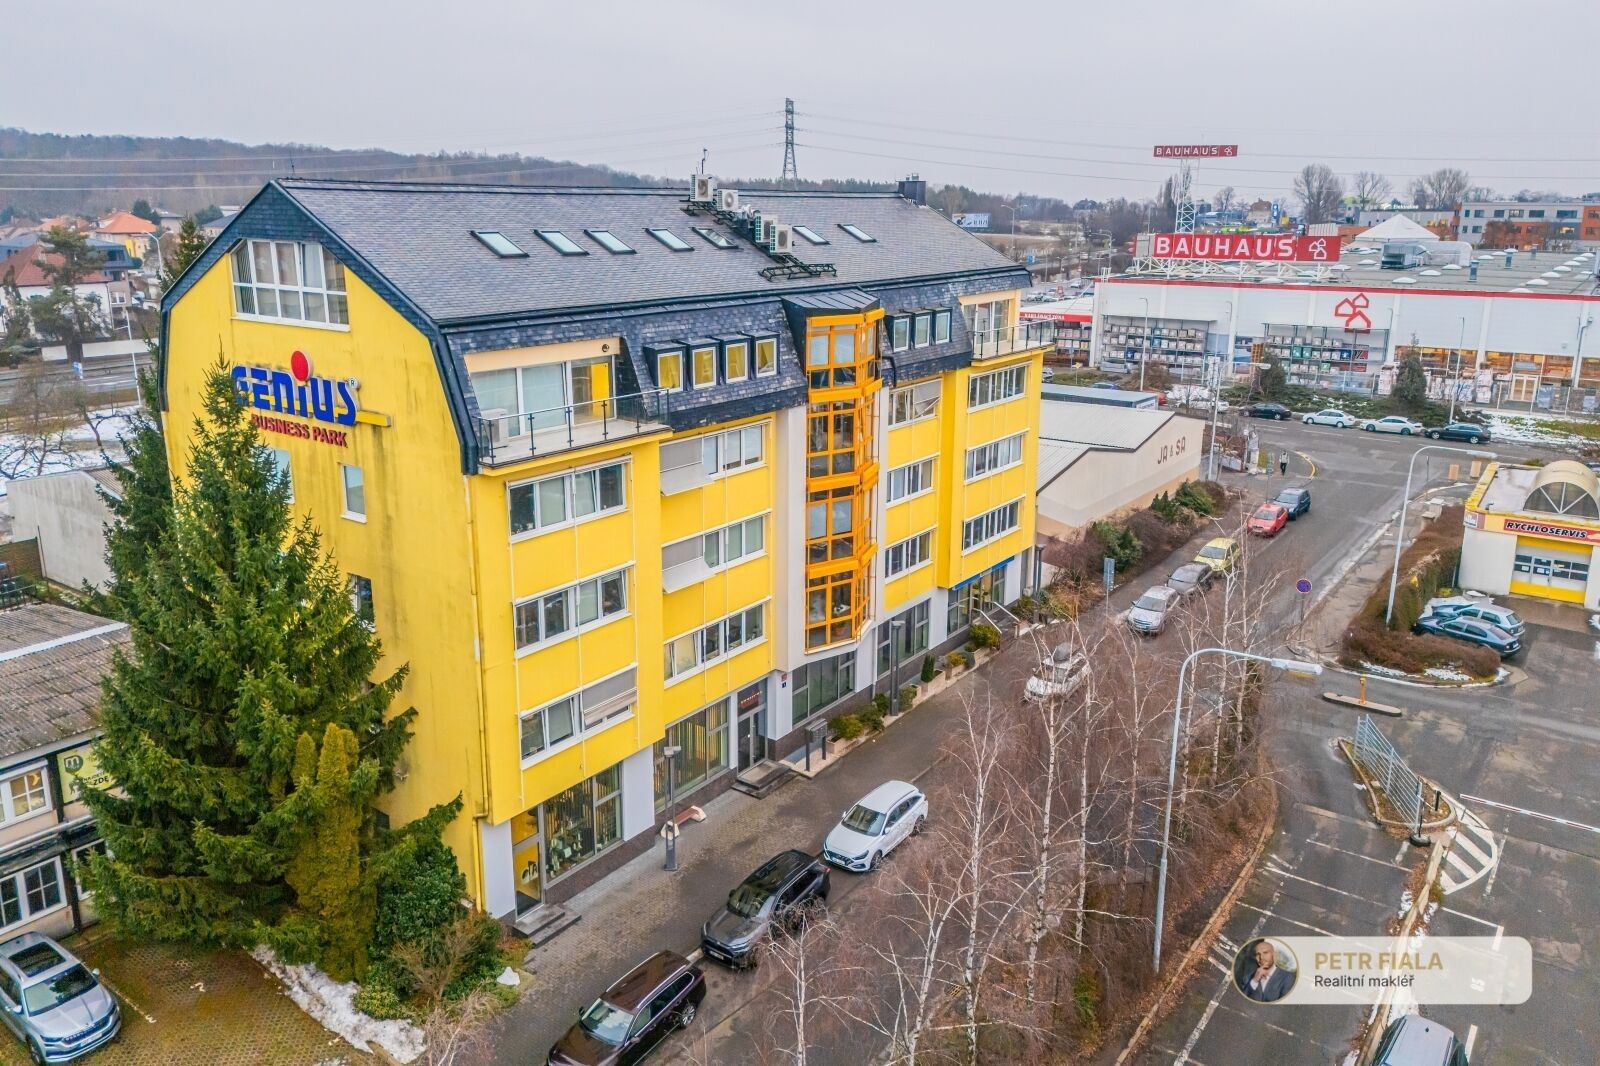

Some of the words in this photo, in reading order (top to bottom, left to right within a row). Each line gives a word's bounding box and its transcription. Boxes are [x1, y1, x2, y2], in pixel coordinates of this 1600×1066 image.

[1156, 147, 1218, 156] BAUHAUS
[1156, 237, 1293, 257] BAUHAUS
[250, 413, 310, 440] BUSINESS
[312, 426, 349, 448] PARK
[1157, 445, 1168, 464] JA
[1176, 436, 1186, 456] SA
[1506, 522, 1587, 539] RYCHLOSERVIS
